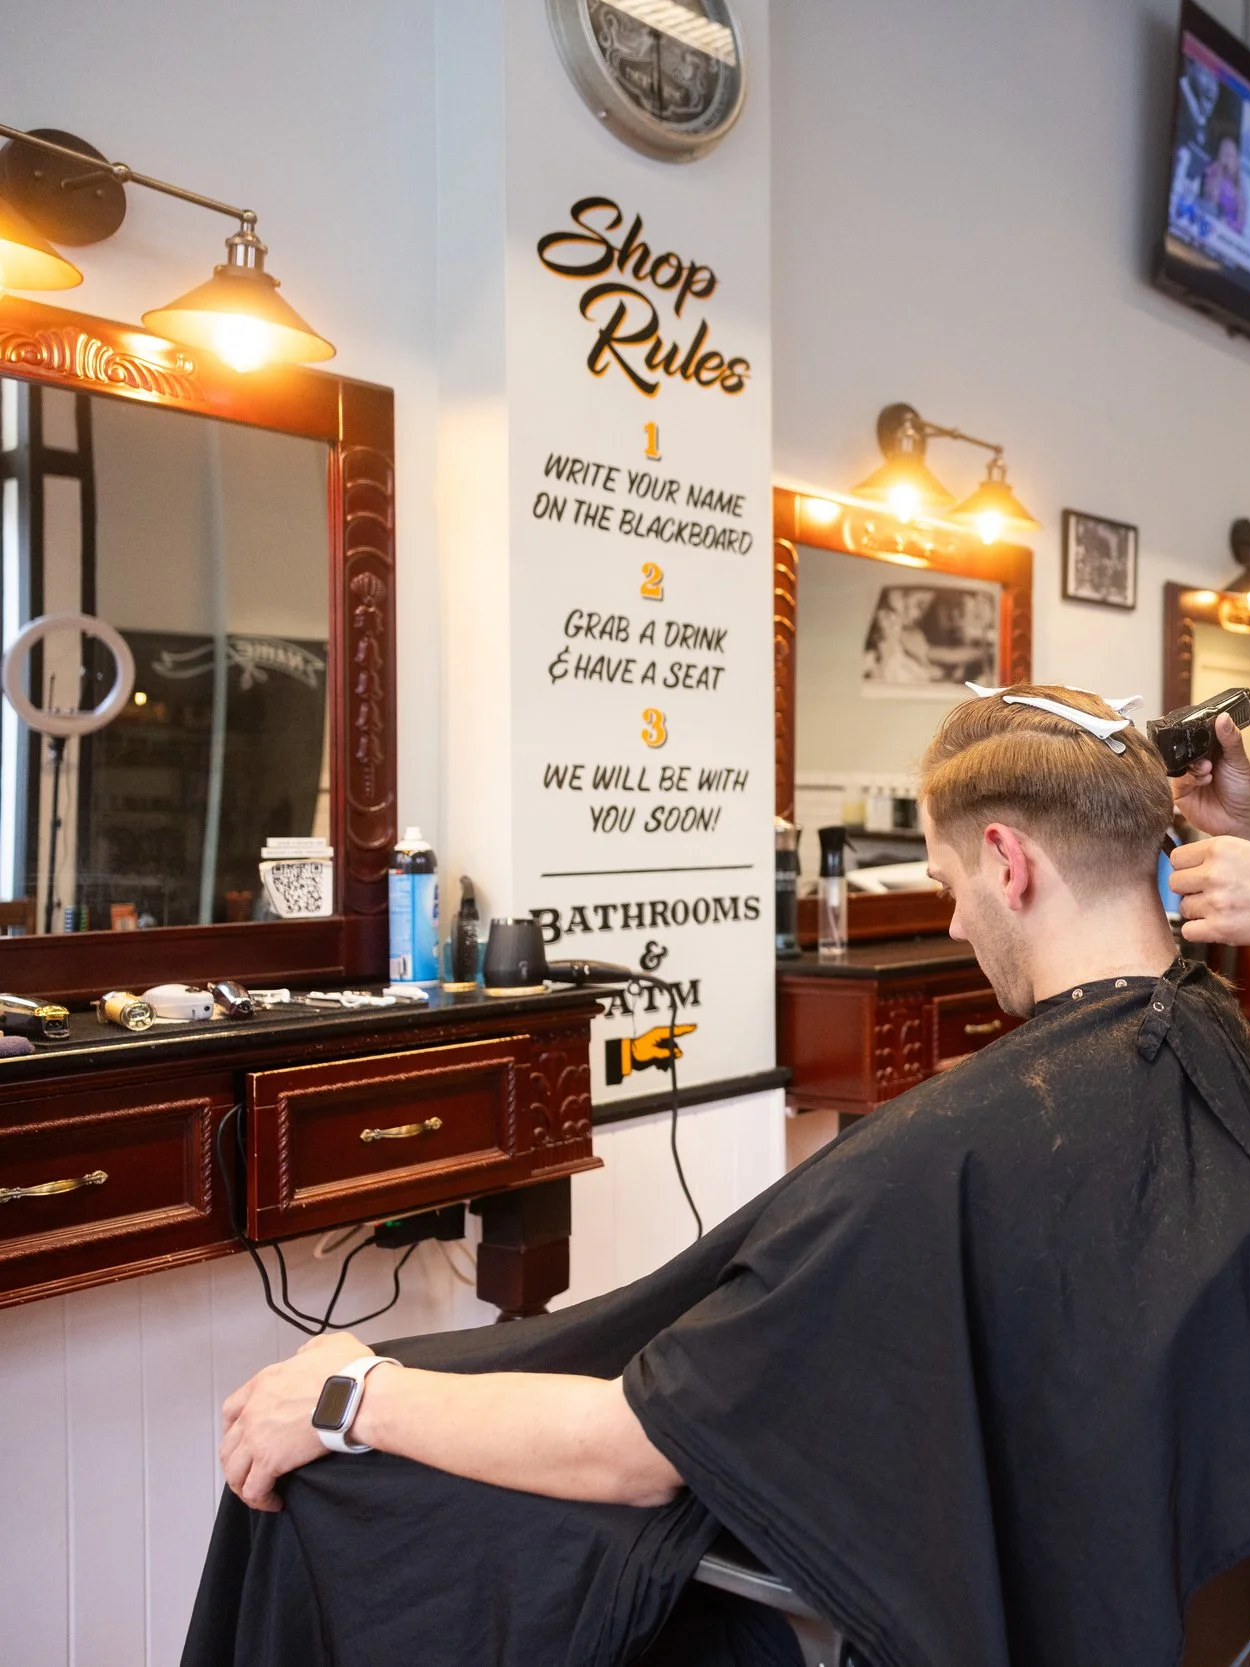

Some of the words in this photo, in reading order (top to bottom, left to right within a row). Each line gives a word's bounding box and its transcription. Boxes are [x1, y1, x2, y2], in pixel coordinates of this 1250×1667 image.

[537, 196, 719, 319] Shop
[579, 282, 751, 397] Rules
[643, 422, 661, 461] 1
[543, 453, 620, 493] WRITE
[628, 470, 681, 505] YOUR
[686, 484, 746, 518] NAME
[532, 491, 567, 523] ON
[574, 499, 614, 532] THE
[619, 509, 753, 555] BLACKBOARD
[640, 562, 664, 602] 2
[564, 609, 630, 643] GRAB
[639, 620, 656, 645] A
[664, 621, 728, 653] DRINK
[574, 653, 637, 684] HAVE
[641, 660, 657, 685] A
[663, 661, 725, 691] SEAT
[641, 708, 667, 749] 3
[543, 762, 585, 791] WE
[592, 764, 650, 792] WILL
[658, 766, 691, 792] BE
[697, 767, 749, 793] WITH
[590, 805, 636, 834] YOU
[644, 805, 722, 834] SOON!
[529, 896, 760, 945] BATHROOMS
[639, 940, 668, 972] &
[604, 979, 701, 1019] ATM
